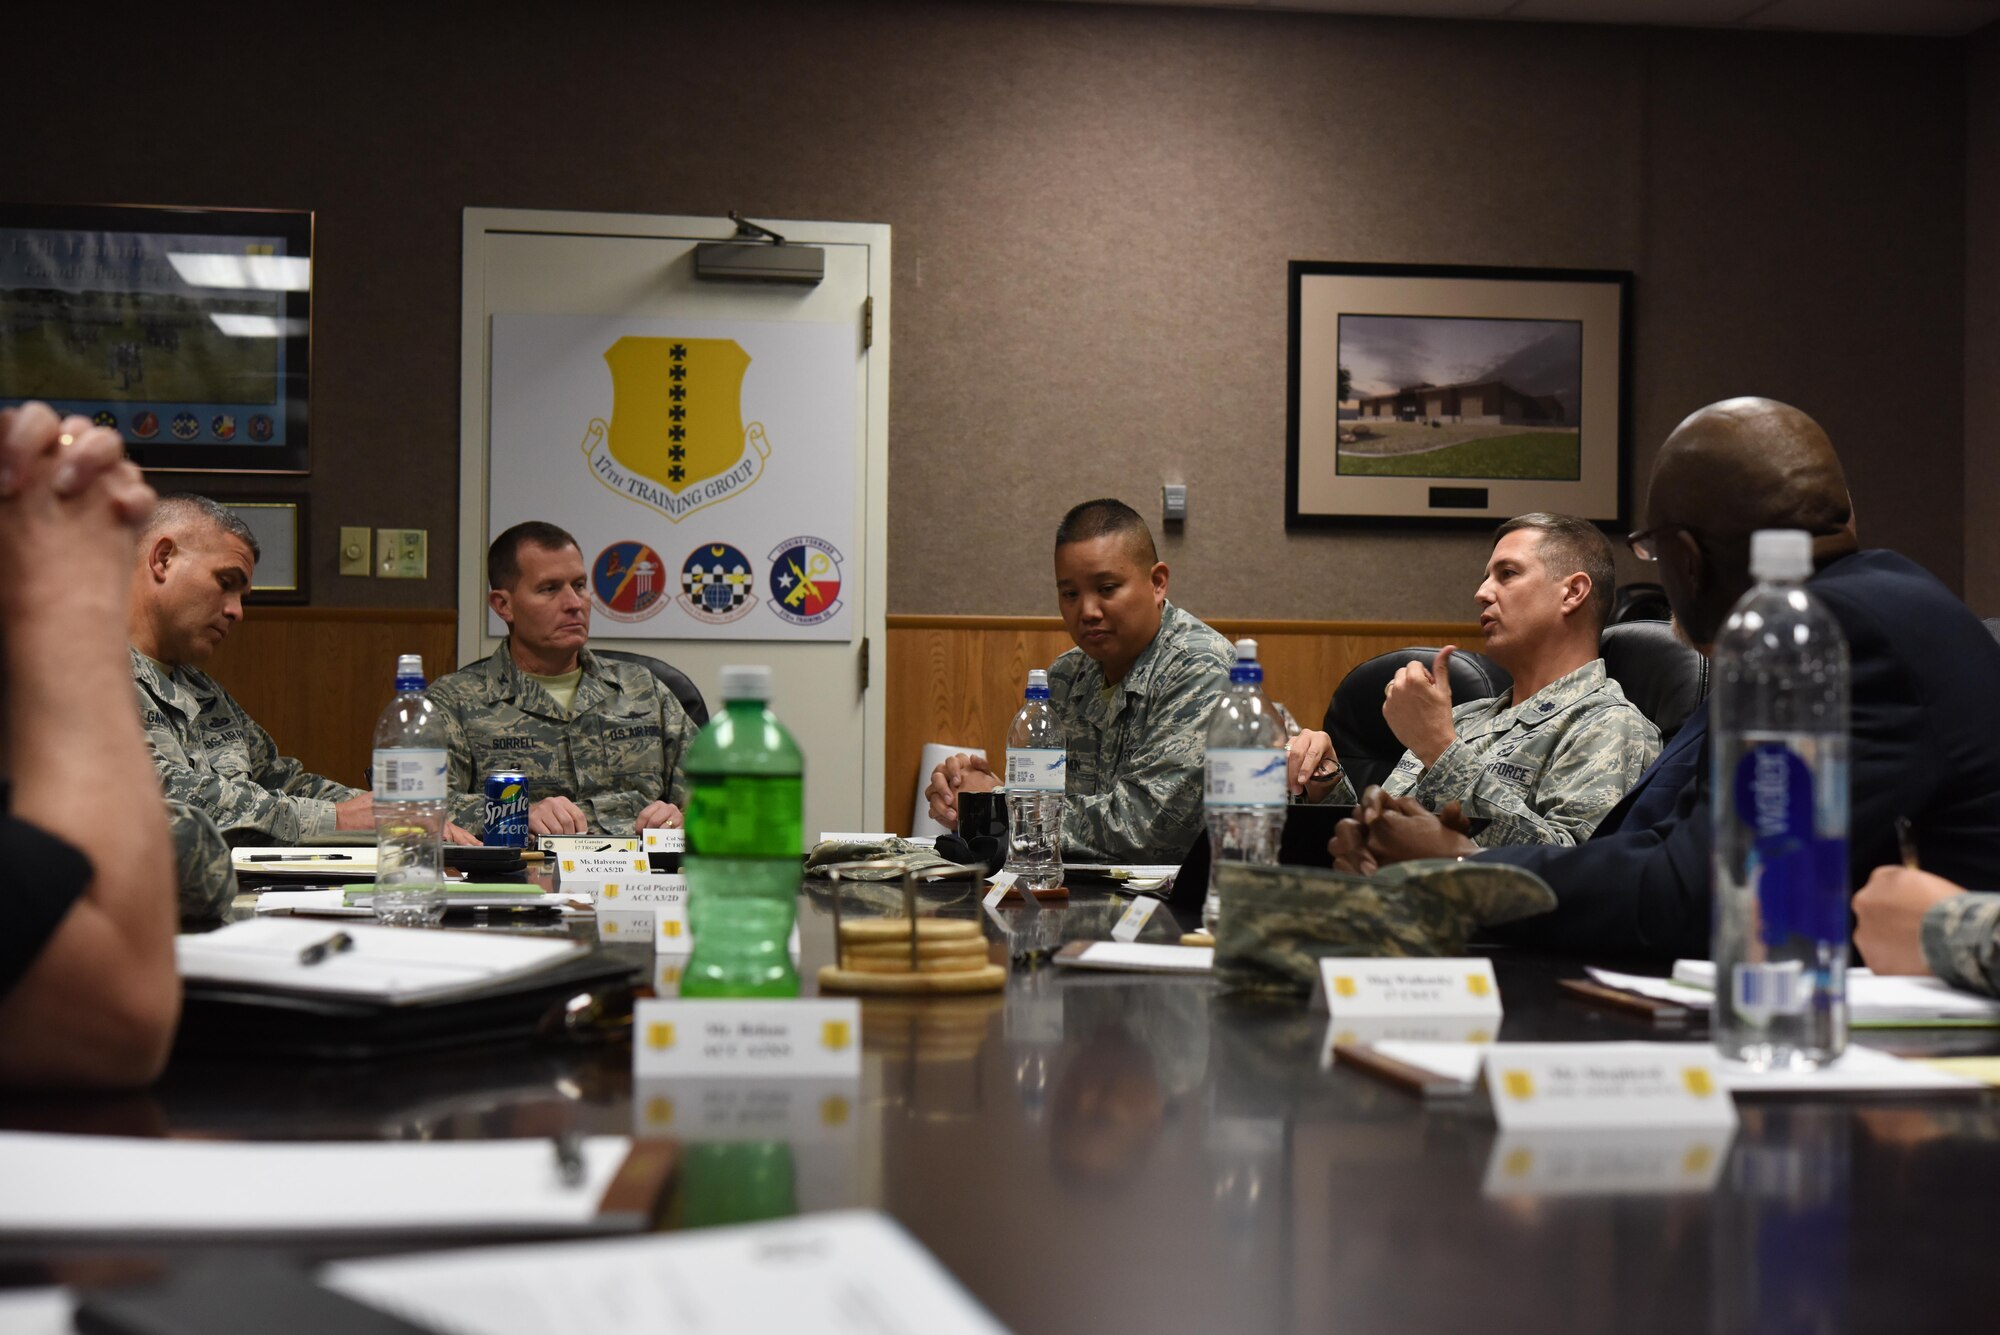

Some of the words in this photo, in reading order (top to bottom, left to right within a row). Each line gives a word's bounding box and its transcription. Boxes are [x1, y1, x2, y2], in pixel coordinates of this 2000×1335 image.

[594, 455, 624, 488] 17TH
[627, 478, 702, 514] TRAINING
[704, 459, 753, 499] GROUP
[220, 729, 237, 742] AIR
[493, 737, 536, 750] SORRELL
[1490, 761, 1530, 782] FORCE
[484, 793, 529, 825] Sprite
[497, 824, 529, 835] zero
[636, 883, 651, 891] Col
[631, 894, 649, 902] ACC
